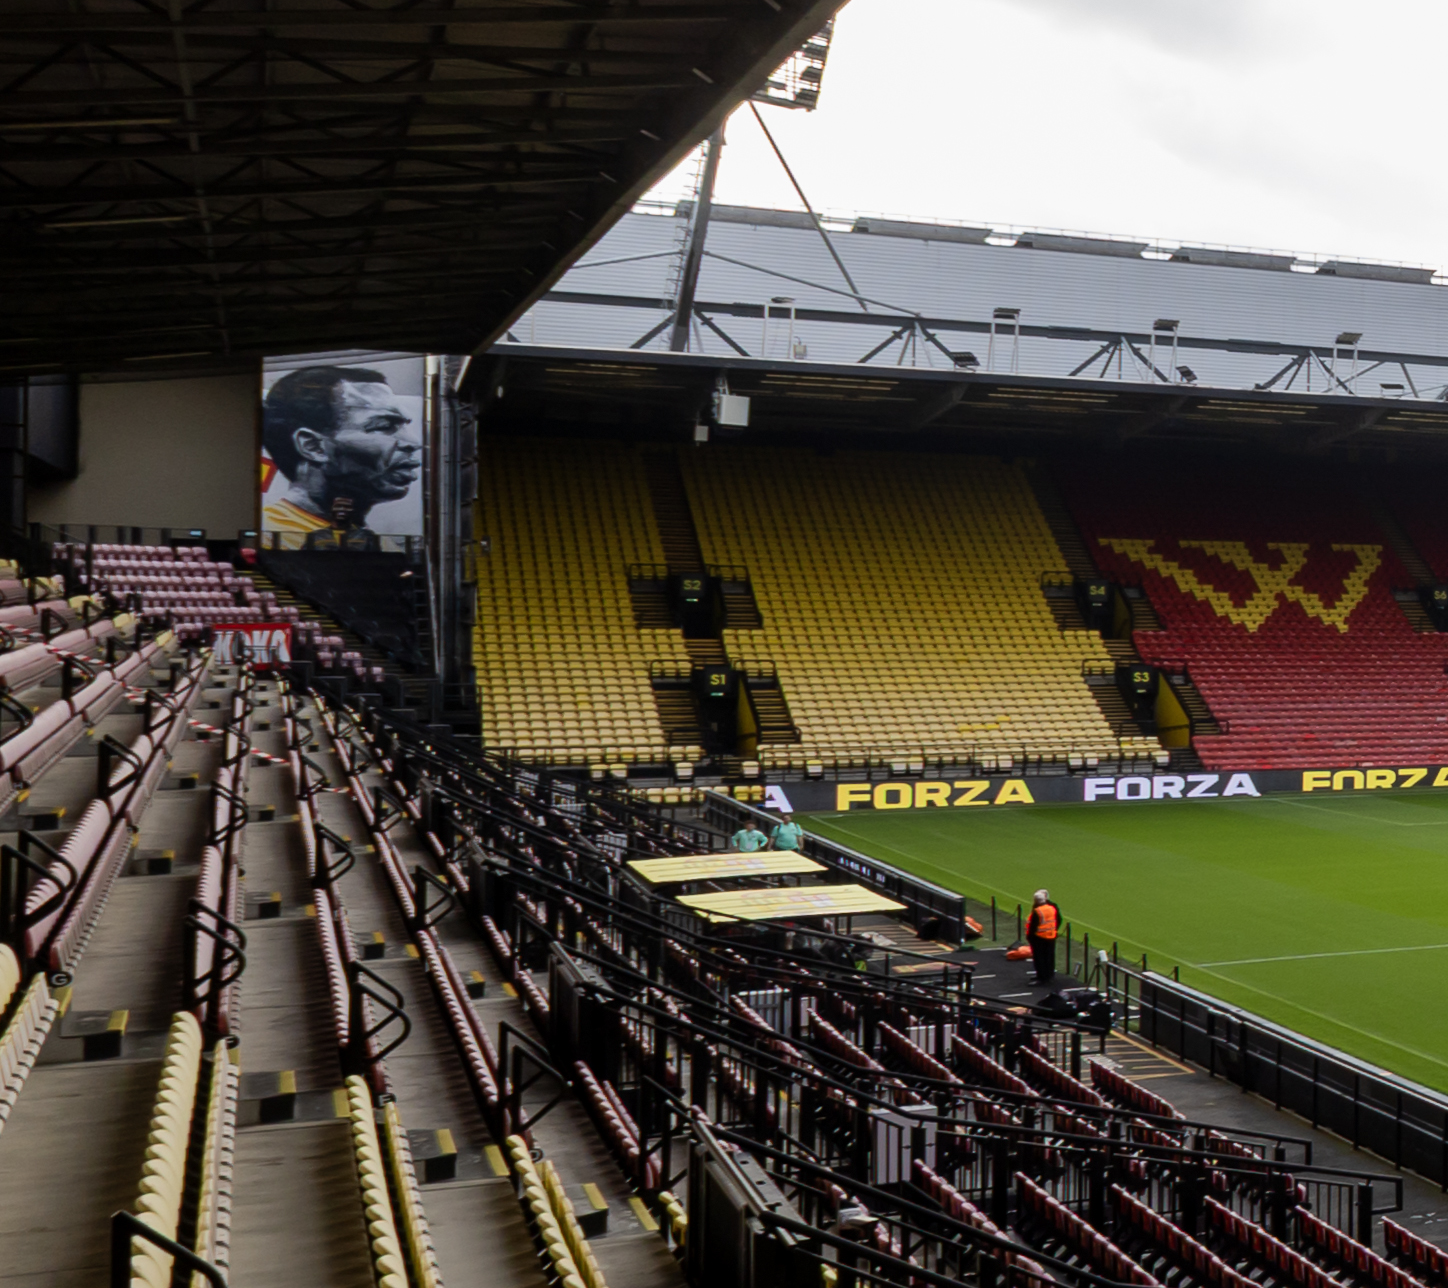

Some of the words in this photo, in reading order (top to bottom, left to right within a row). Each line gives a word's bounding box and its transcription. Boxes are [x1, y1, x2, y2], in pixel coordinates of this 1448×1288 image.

[682, 578, 702, 591] S2
[1089, 584, 1106, 596] S4
[1434, 590, 1447, 600] S6
[710, 673, 726, 685] S1
[1133, 671, 1150, 683] S3
[836, 779, 1035, 811] FORZA
[1083, 772, 1262, 802] FORZA
[52, 973, 69, 986] G
